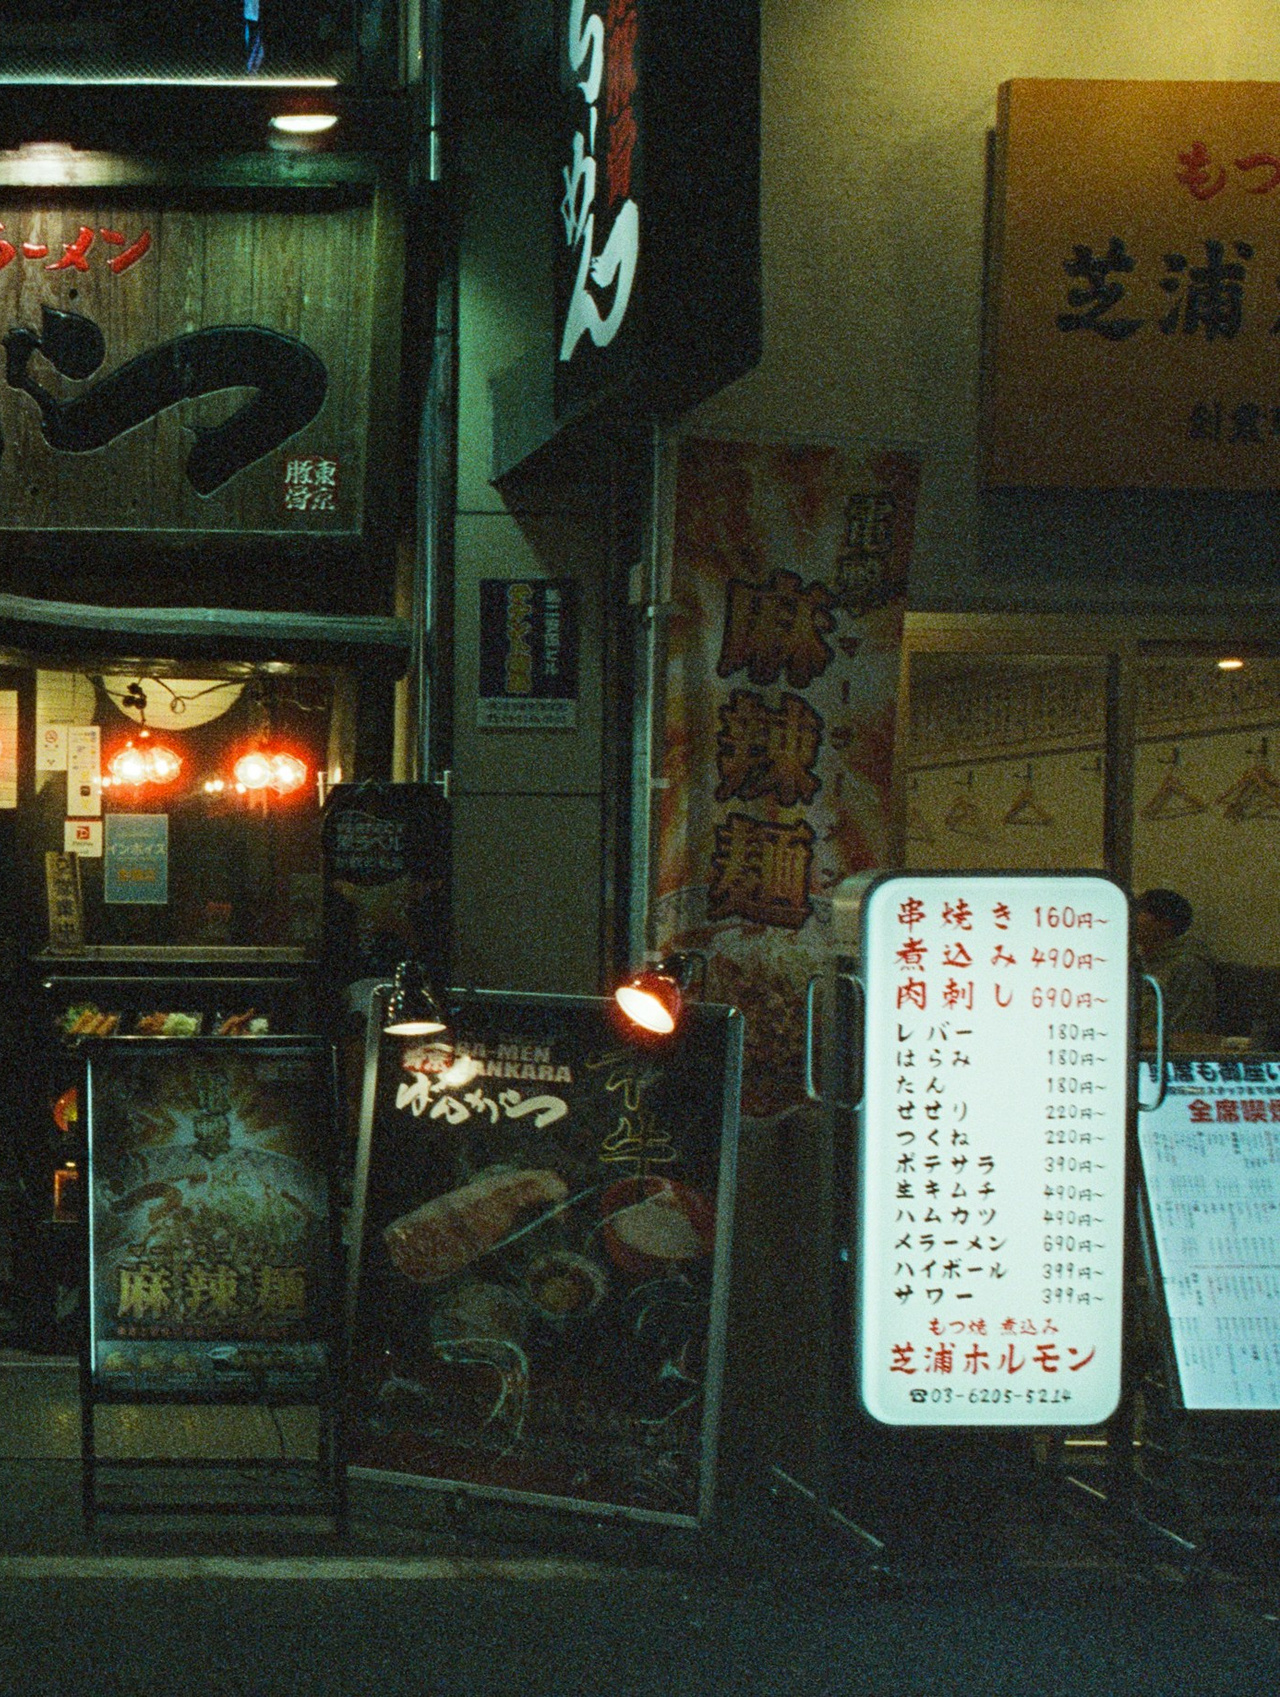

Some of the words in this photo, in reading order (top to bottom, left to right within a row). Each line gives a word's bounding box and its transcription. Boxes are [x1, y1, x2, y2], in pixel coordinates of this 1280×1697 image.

[1058, 237, 1280, 342] 芝浦
[896, 896, 1013, 934] 串焼き
[894, 936, 1017, 972] 煮込み
[895, 976, 1014, 1011] 肉刺し
[897, 1021, 973, 1043] レバー
[896, 1048, 971, 1068] はらみ
[896, 1075, 945, 1095] たん
[896, 1100, 968, 1122] せせり
[896, 1128, 970, 1147] つくね
[895, 1152, 995, 1176] ポテサラ
[895, 1179, 996, 1200] 生キムチ
[894, 1207, 997, 1226] ハムカツ
[894, 1233, 1007, 1252] メラーメン
[894, 1258, 1008, 1280] ハイボール
[893, 1284, 973, 1305] サワー
[928, 1317, 988, 1336] もつ焼
[1000, 1316, 1060, 1336] 煮込み
[889, 1341, 1096, 1376] 芝浦ホルモン
